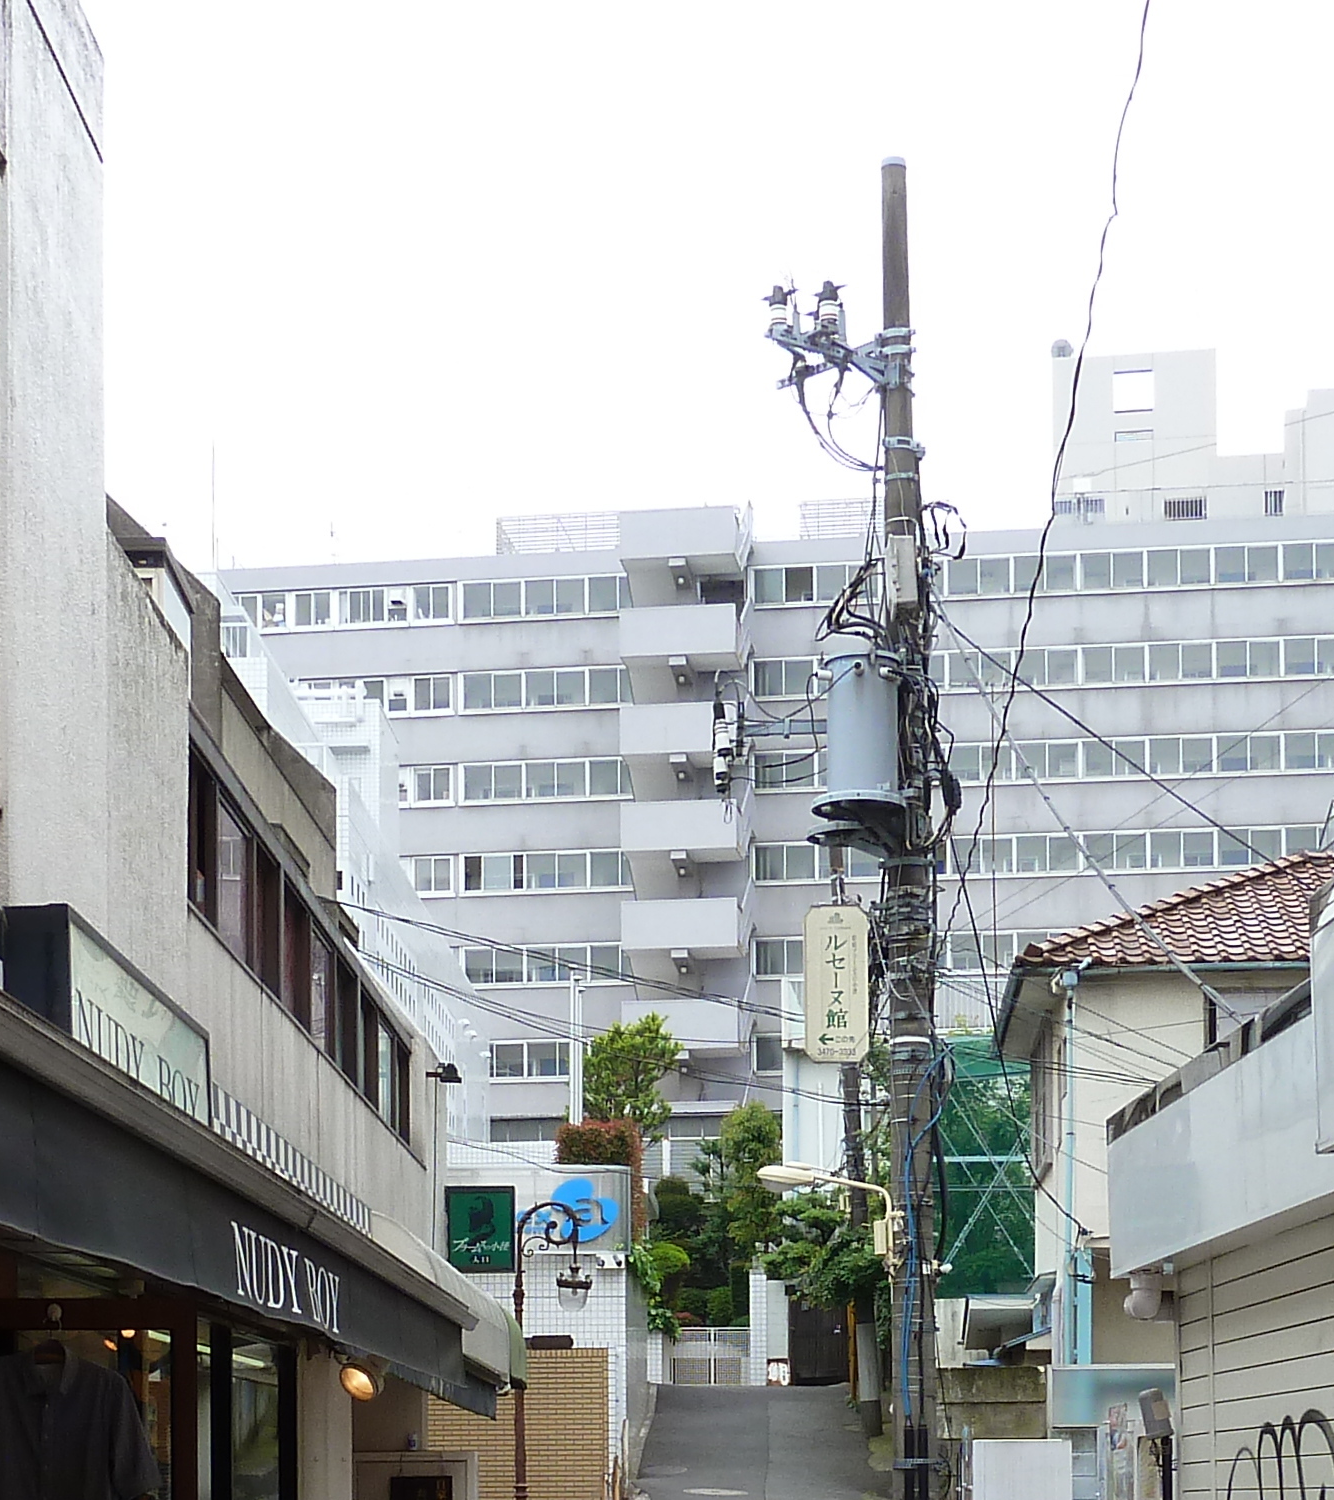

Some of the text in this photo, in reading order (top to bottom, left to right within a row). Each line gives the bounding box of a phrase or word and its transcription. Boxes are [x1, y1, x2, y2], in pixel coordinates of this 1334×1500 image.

[825, 935, 848, 1029] ルセーヌ館
[74, 988, 201, 1120] NUDY BOY
[230, 1220, 342, 1334] NUDY BOY
